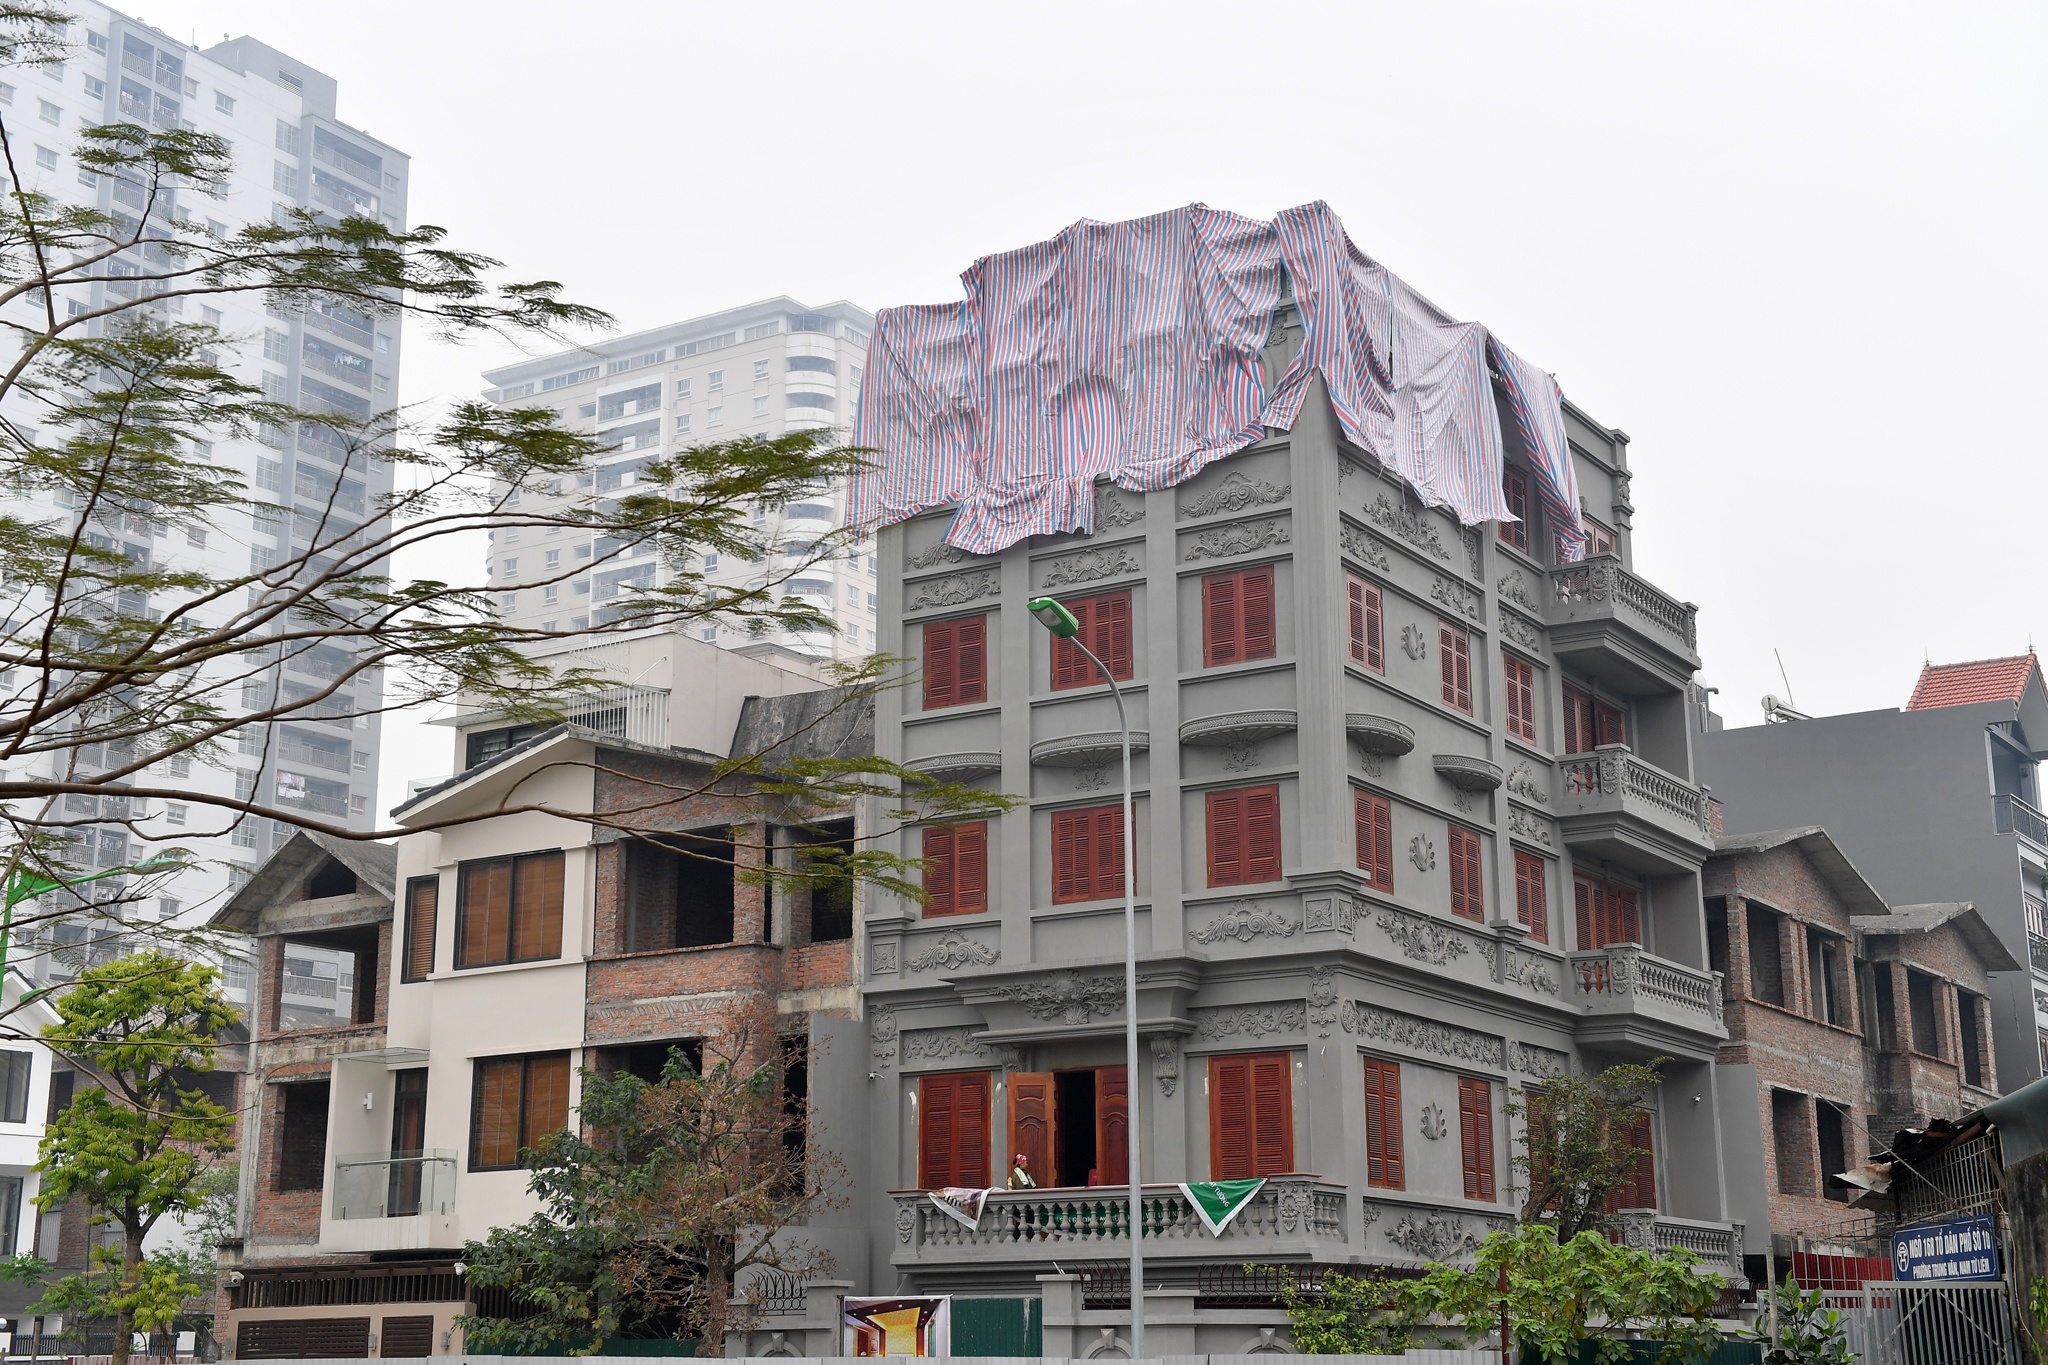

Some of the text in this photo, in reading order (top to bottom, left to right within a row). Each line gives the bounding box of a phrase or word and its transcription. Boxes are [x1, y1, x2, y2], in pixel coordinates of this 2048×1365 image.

[1923, 1236, 1935, 1257] 168
[1944, 1230, 1958, 1254] DÂN
[1959, 1226, 1972, 1253] PHỐ
[1982, 1229, 1991, 1250] 10
[1913, 1261, 1931, 1279] PHƯỜNG
[1932, 1262, 1948, 1277] TRUNG
[1960, 1260, 1971, 1275] NAM
[1971, 1256, 1978, 1274] TỪ
[1978, 1255, 1990, 1273] LIÊM
